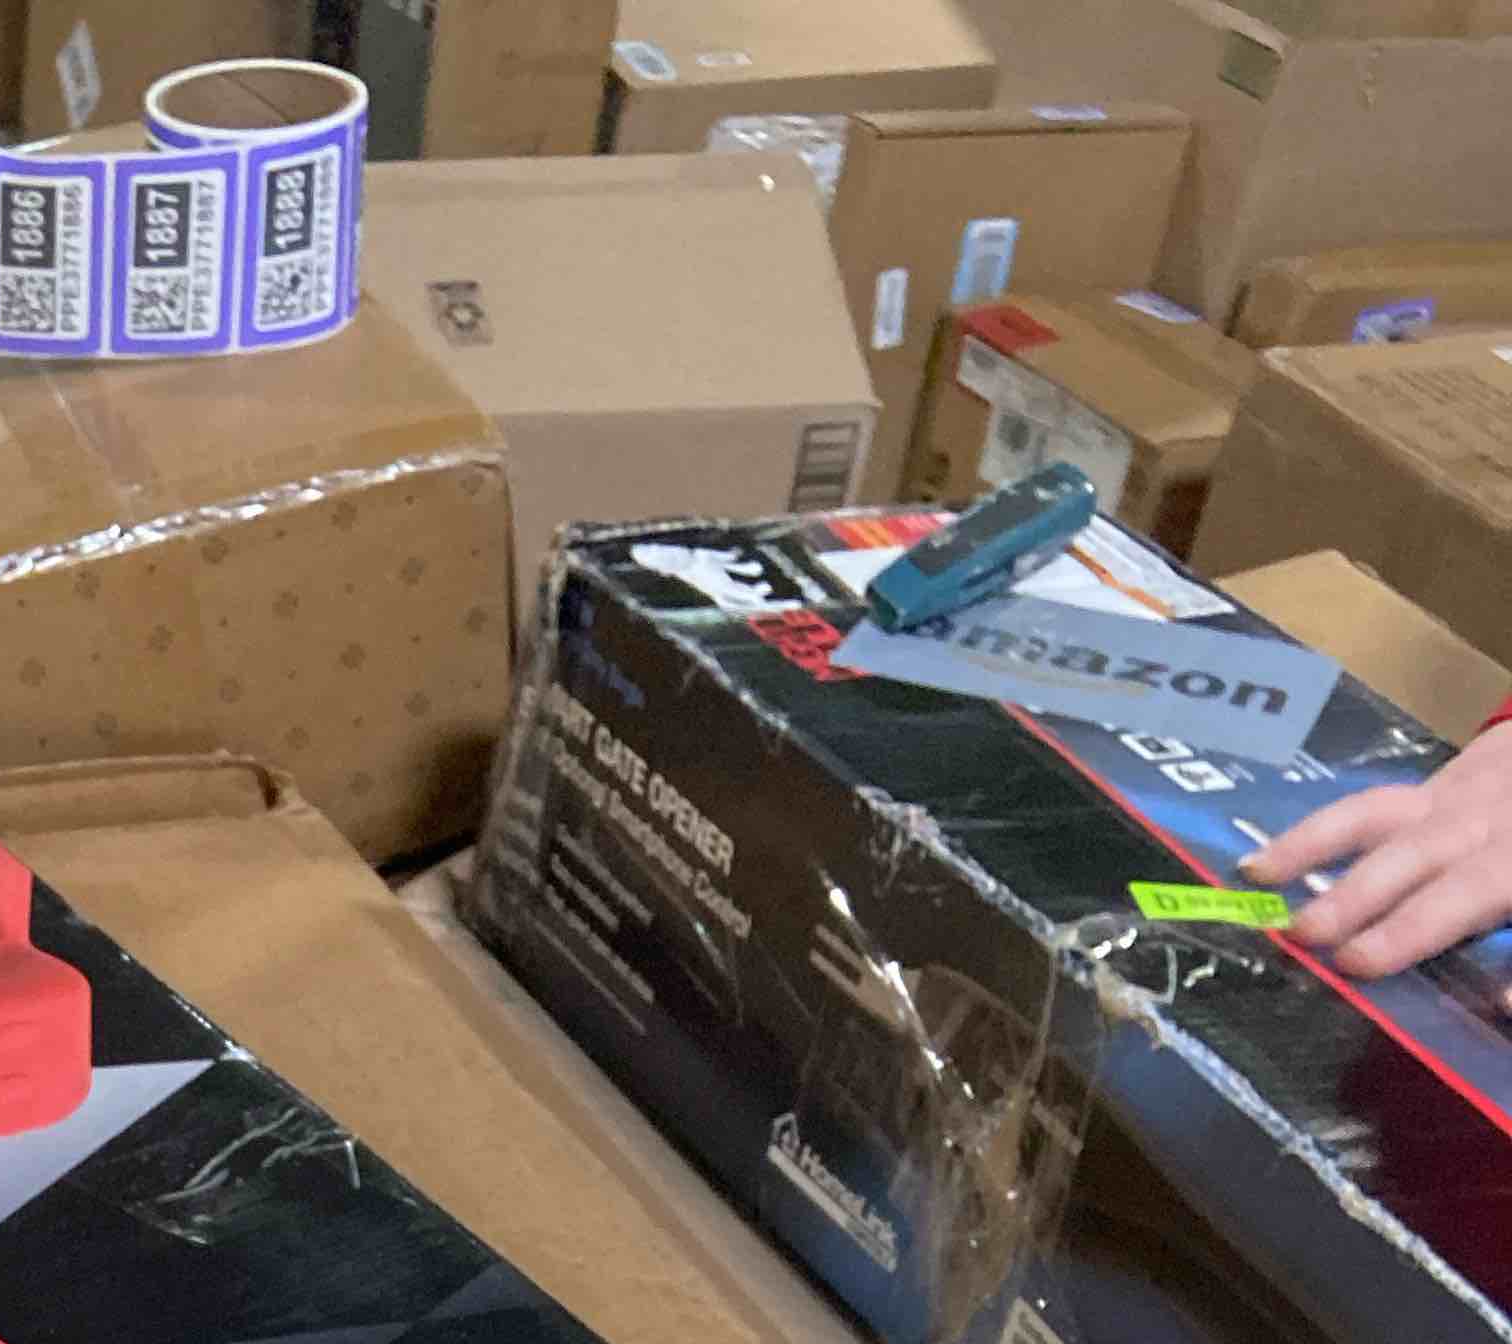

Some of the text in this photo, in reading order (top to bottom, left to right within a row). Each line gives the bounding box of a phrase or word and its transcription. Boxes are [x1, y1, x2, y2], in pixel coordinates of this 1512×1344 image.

[9, 188, 47, 263] 1886
[144, 187, 183, 264] 1887
[273, 165, 307, 249] 1888
